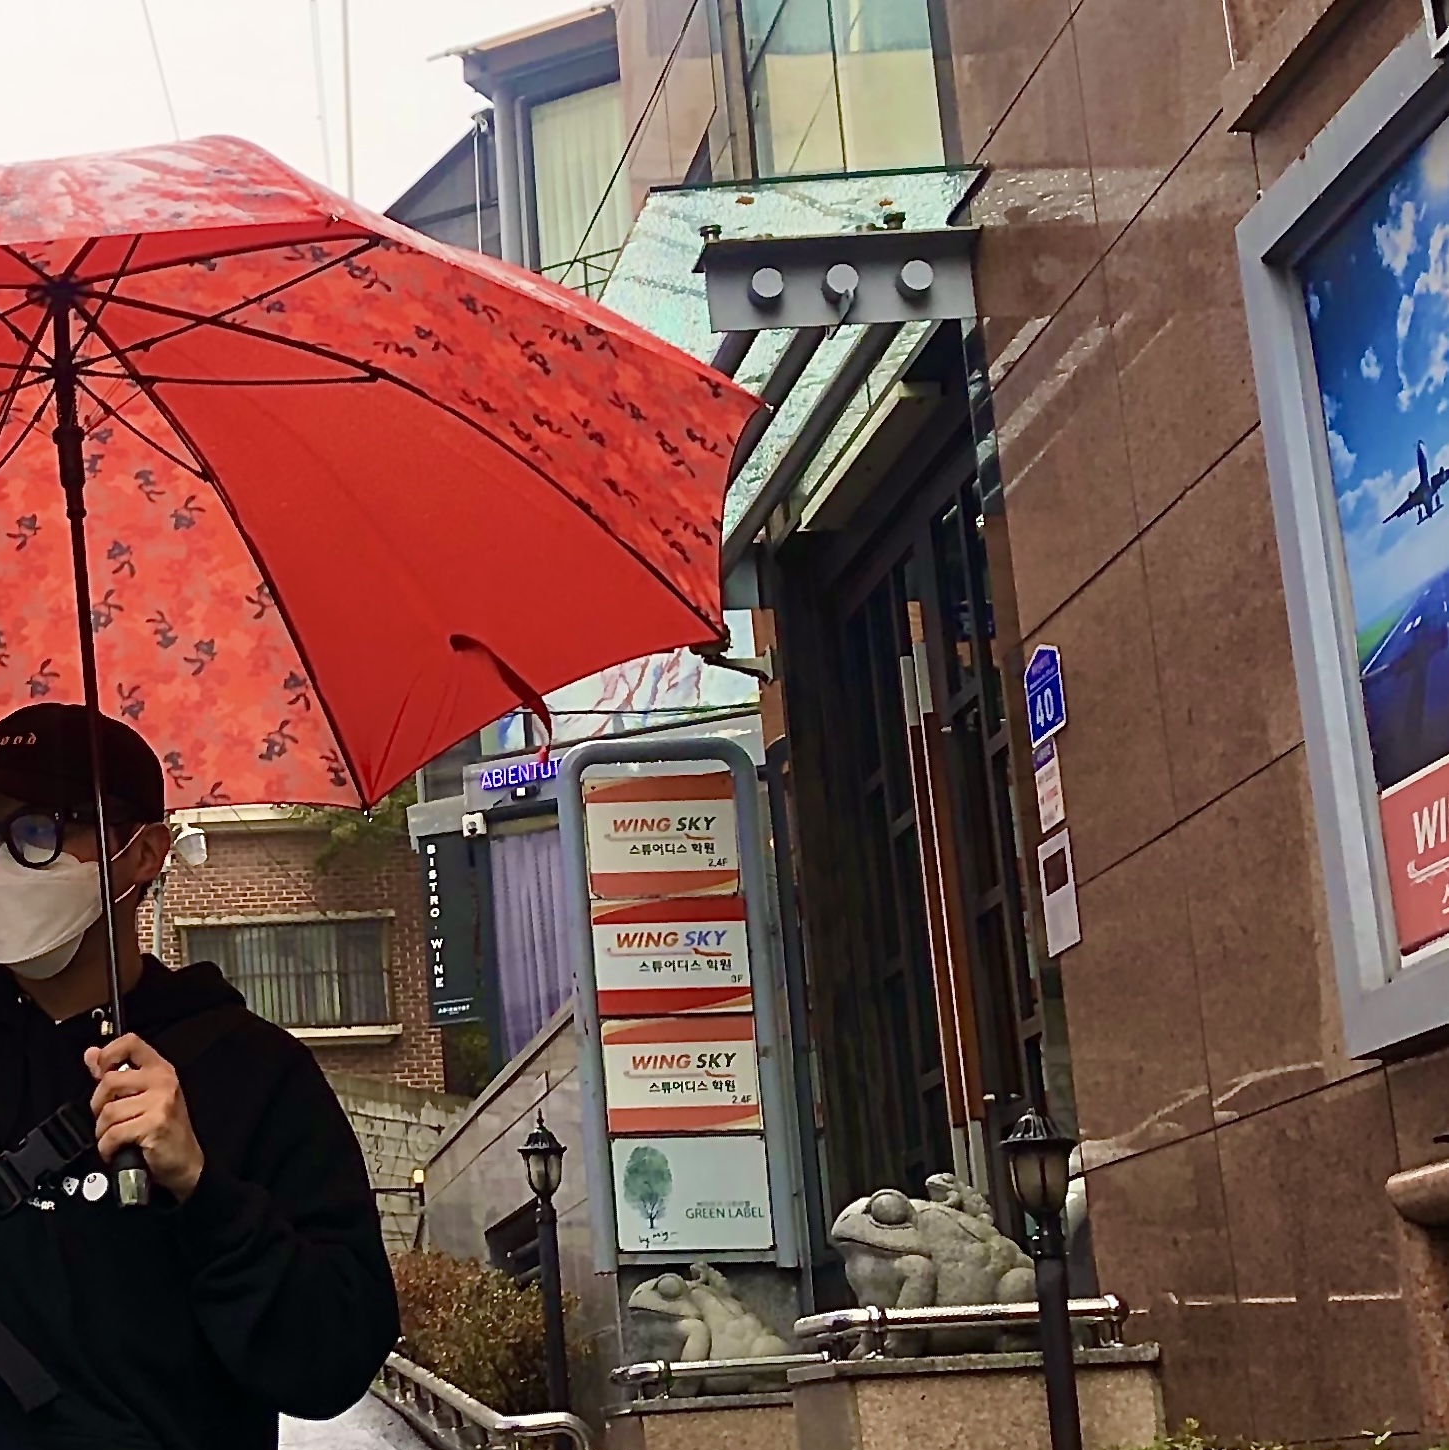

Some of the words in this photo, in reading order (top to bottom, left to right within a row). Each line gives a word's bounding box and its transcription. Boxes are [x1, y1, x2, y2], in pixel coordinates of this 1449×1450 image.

[1036, 687, 1054, 728] 40
[612, 817, 672, 833] WING
[676, 816, 717, 832] SKY
[691, 842, 716, 855] 학원
[426, 844, 441, 918] BISTRO
[616, 931, 680, 948] WING
[683, 929, 728, 947] SKY
[430, 937, 444, 989] WINE
[631, 1053, 692, 1070] WING
[696, 1052, 737, 1069] SKY
[685, 1207, 726, 1219] GREEN
[728, 1206, 765, 1219] LABEL
